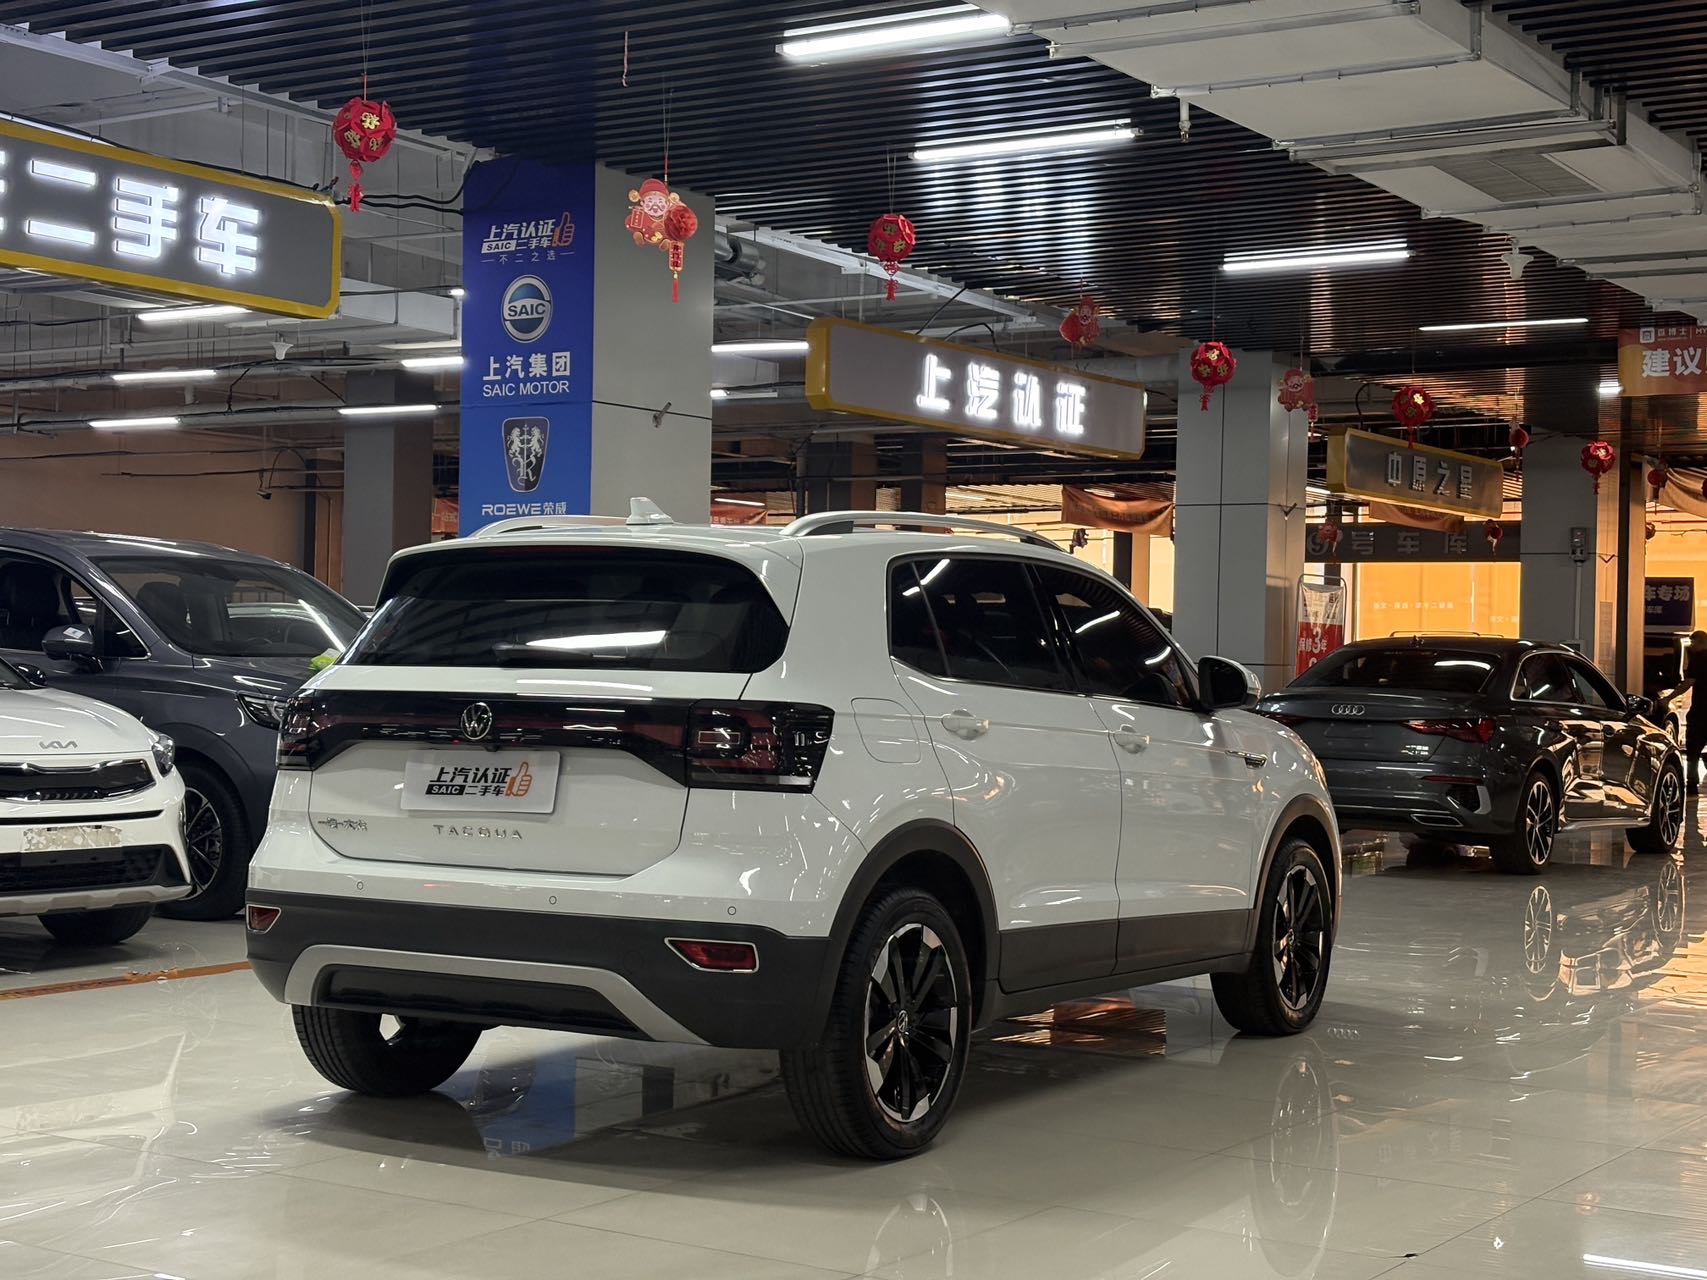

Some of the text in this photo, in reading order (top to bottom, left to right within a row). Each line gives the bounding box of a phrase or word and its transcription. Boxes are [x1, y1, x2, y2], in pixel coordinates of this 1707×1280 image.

[0, 151, 260, 275] 二手车
[483, 219, 555, 242] 上汽认证
[486, 237, 553, 251] SAIC 二手车
[499, 250, 556, 265] 不二之选
[507, 302, 546, 317] SAIC
[483, 352, 571, 381] 上汽集团
[1642, 346, 1707, 378] 建议
[483, 380, 570, 397] SAIC MOTOR
[916, 352, 1087, 434] 上汽认证
[1387, 452, 1472, 499] 中原之星
[429, 767, 513, 784] 上汽认证
[431, 785, 506, 796] SAIC 二手车
